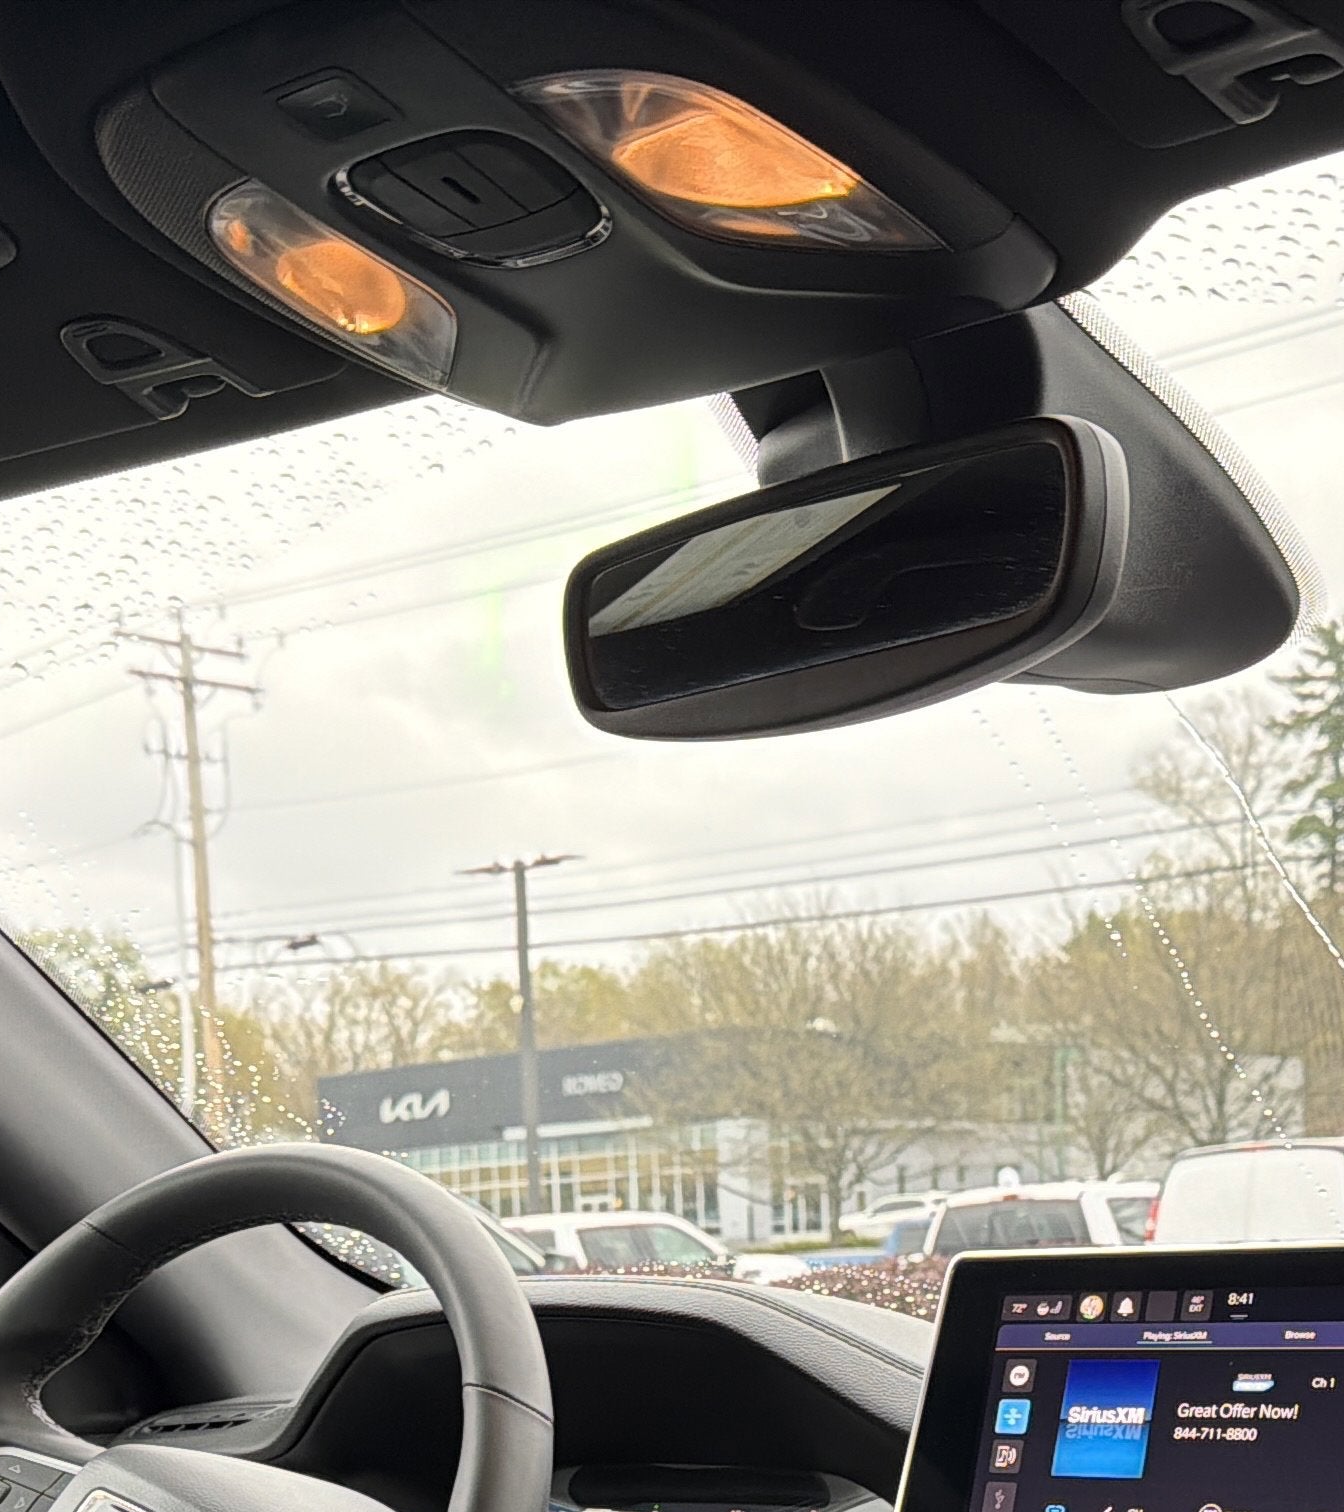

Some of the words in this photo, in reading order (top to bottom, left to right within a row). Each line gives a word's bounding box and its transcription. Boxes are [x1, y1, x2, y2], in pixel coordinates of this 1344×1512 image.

[379, 1087, 451, 1124] KIA
[1227, 1292, 1255, 1307] 8:41
[1284, 1330, 1317, 1340] Browse
[1311, 1377, 1328, 1389] Ch
[1067, 1406, 1146, 1425] SiriusXM
[1177, 1403, 1218, 1419] Great
[1219, 1403, 1257, 1420] Offer
[1258, 1403, 1300, 1420] Now!
[1173, 1427, 1258, 1442] 844-711-8800
